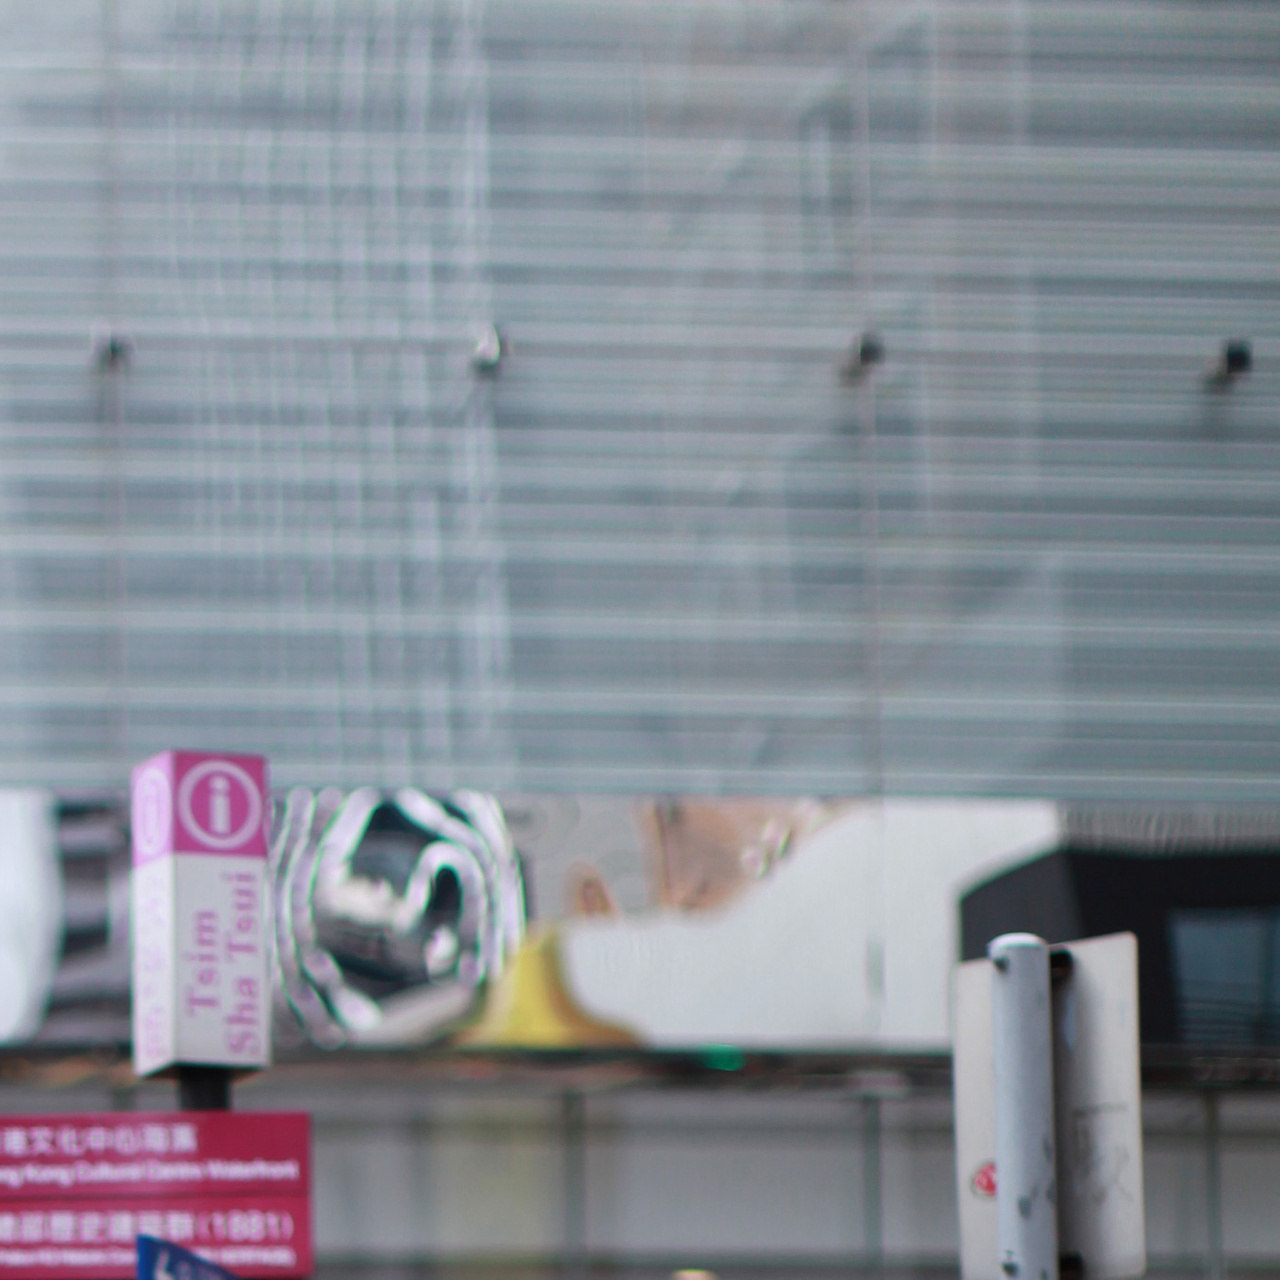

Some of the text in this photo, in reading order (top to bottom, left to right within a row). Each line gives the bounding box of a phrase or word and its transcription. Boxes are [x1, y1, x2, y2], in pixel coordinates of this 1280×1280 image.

[185, 909, 217, 1017] Tsim
[222, 872, 259, 1055] Sha Tsui
